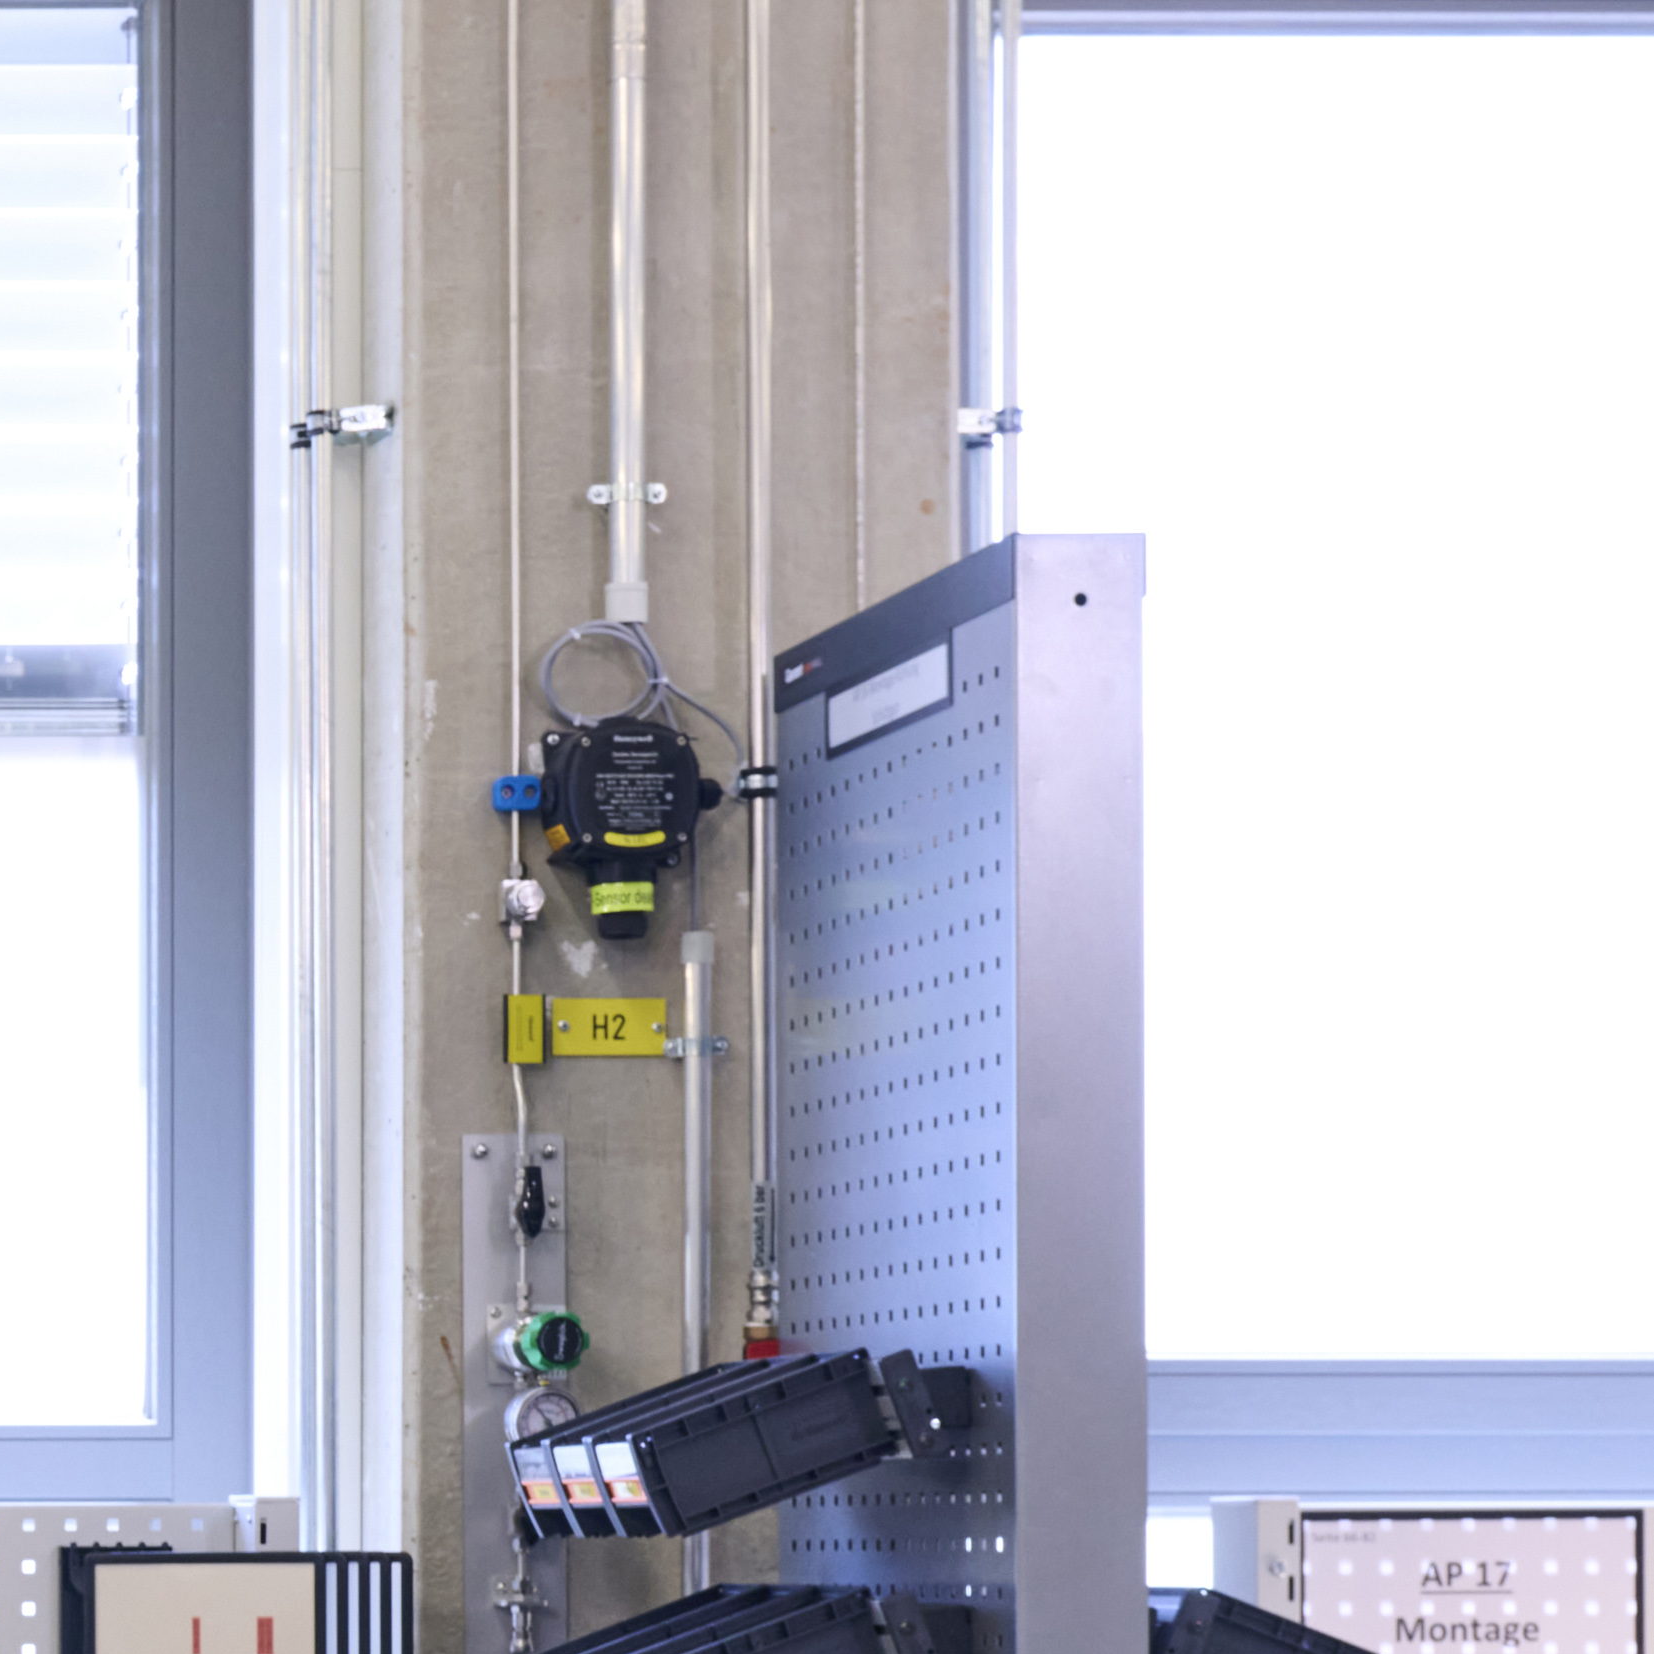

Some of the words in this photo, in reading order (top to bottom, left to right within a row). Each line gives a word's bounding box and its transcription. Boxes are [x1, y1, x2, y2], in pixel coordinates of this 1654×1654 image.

[592, 1014, 626, 1041] H2
[1421, 1562, 1463, 1588] AP
[1476, 1561, 1512, 1587] 17
[1395, 1617, 1540, 1647] Montage
